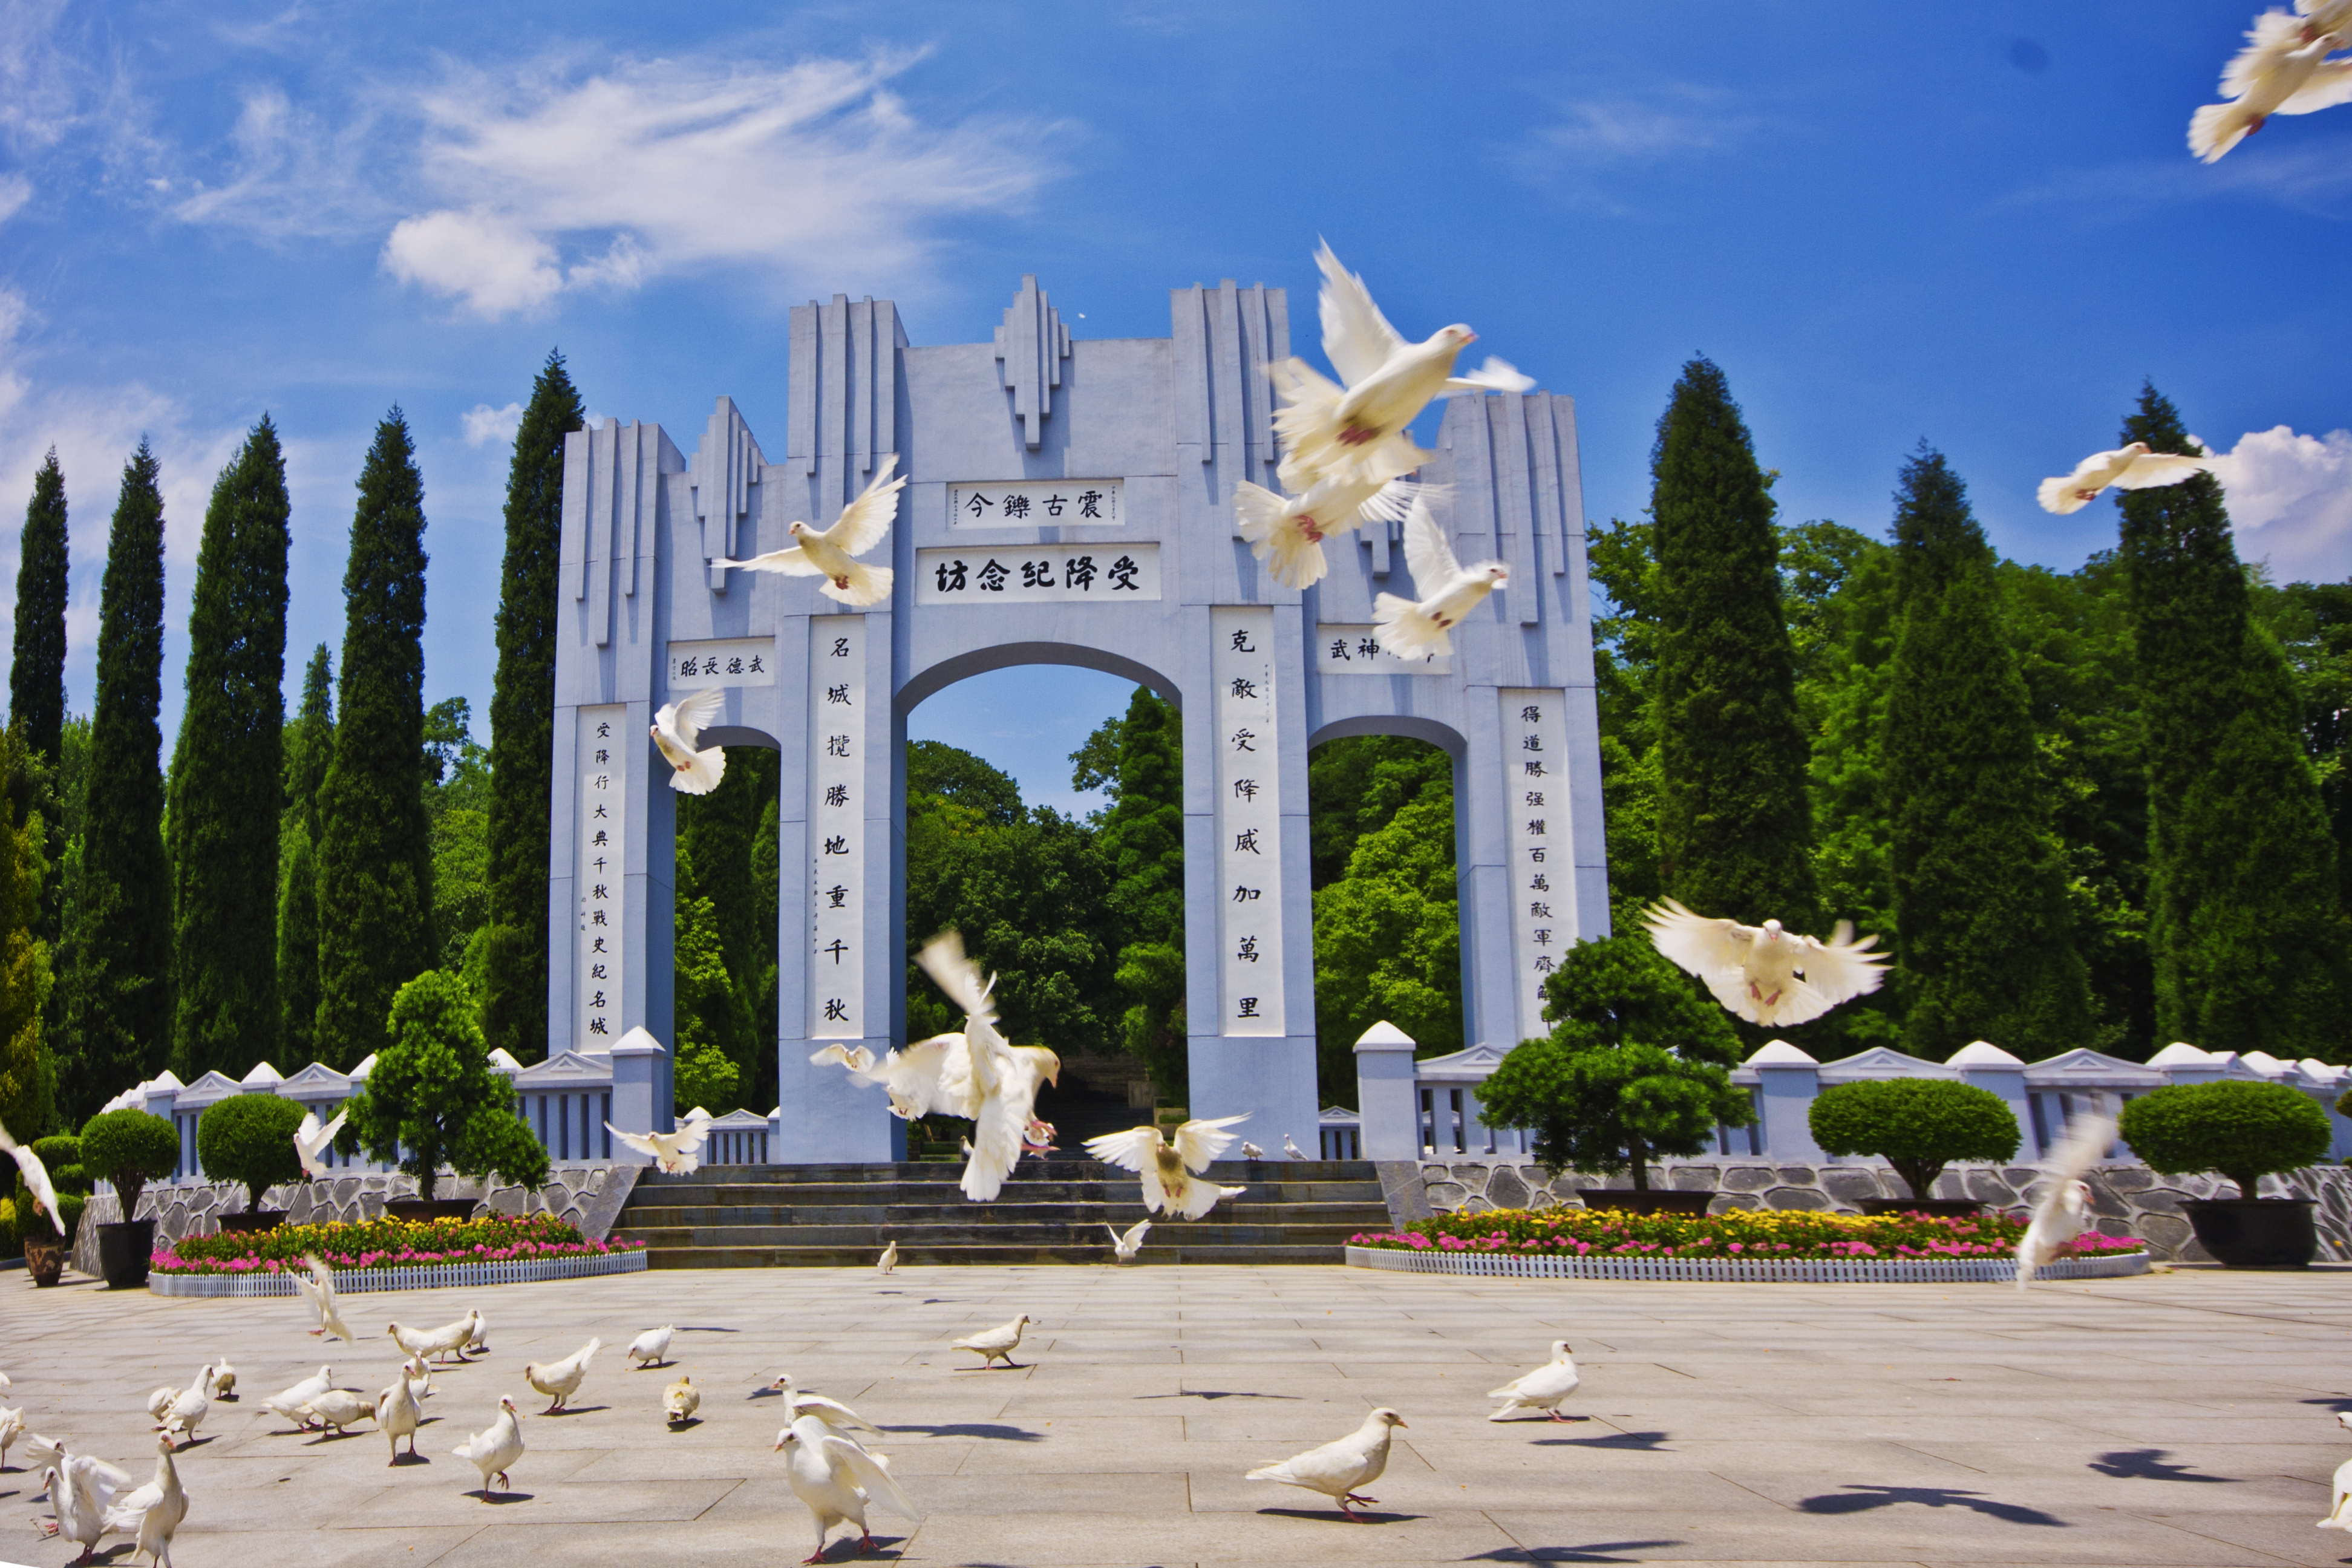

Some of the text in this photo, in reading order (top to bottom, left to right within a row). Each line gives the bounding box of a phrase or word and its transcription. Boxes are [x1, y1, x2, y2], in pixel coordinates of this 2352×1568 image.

[935, 555, 1140, 593] 受降紀念坊
[964, 490, 1103, 519] 震古鑠今
[589, 722, 610, 1035] 受降行大典千秋戰史紀名城
[824, 637, 851, 1022] 名城攬勝地重千秋
[1230, 629, 1261, 1019] 克敵受降威加萬里
